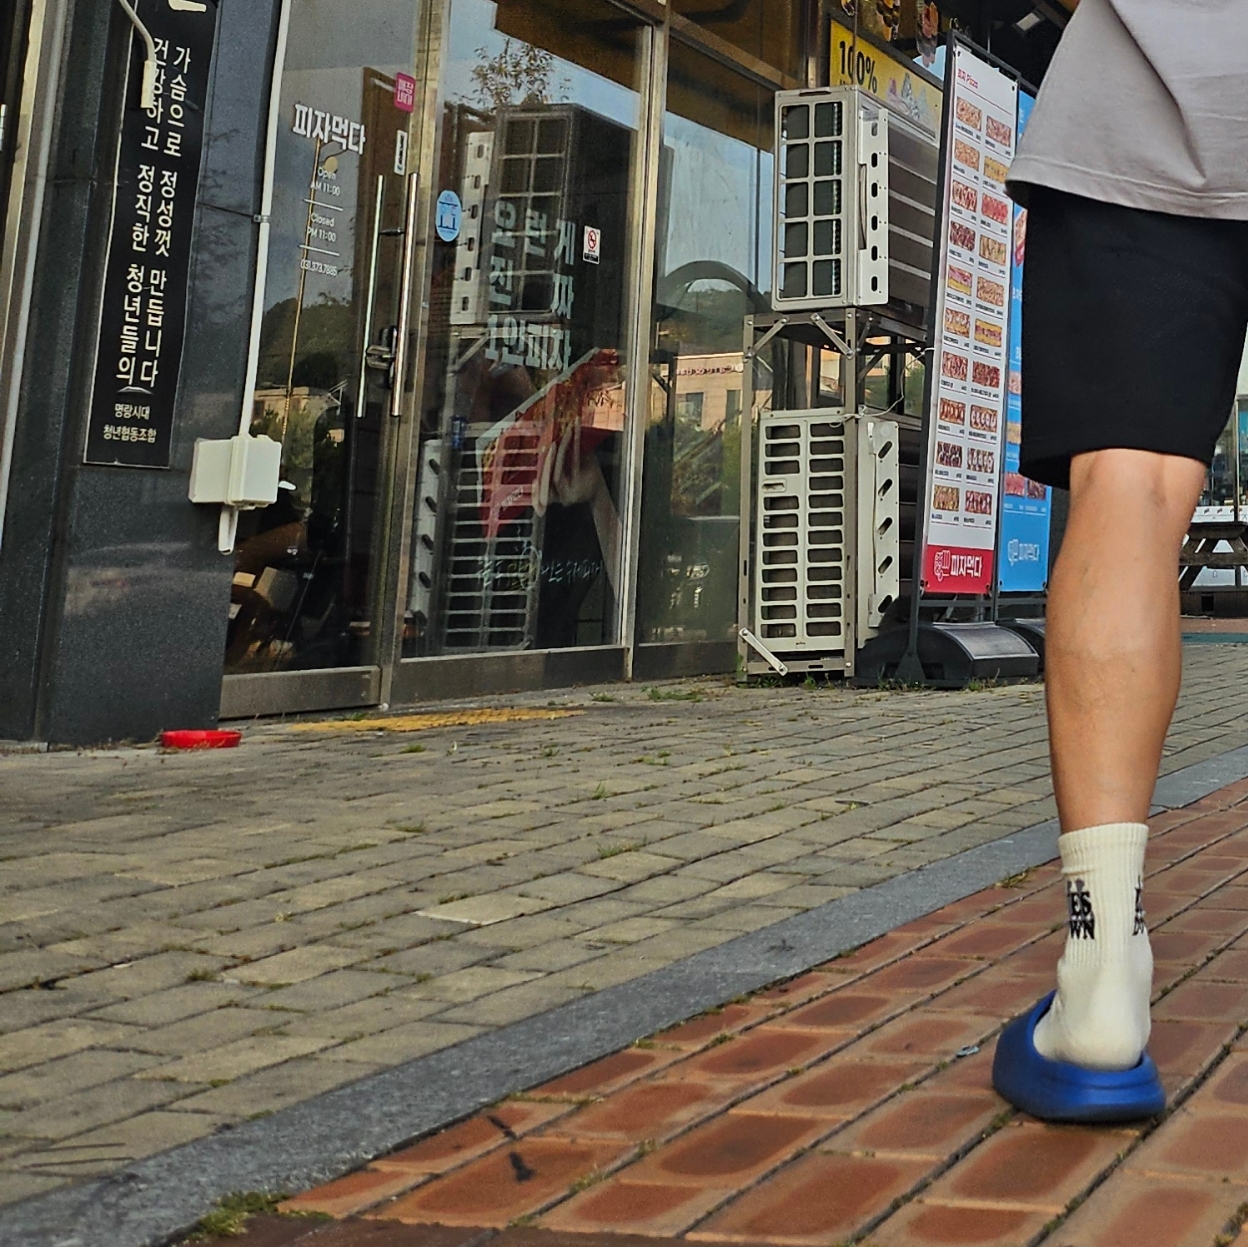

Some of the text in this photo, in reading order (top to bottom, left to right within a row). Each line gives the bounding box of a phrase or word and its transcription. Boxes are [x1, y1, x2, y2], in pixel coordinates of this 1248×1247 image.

[838, 40, 878, 95] 100%
[293, 102, 366, 155] 피자먹다
[131, 163, 157, 253] 정직한
[323, 182, 341, 196] 11:00
[139, 44, 192, 389] 가슴으로 정성껏 만듭니다
[318, 228, 337, 243] 11:00
[115, 262, 145, 388] 청년들의
[114, 402, 151, 420] 명랑시대
[103, 423, 157, 444] 청년협동조합
[950, 554, 983, 578] 피자먹다
